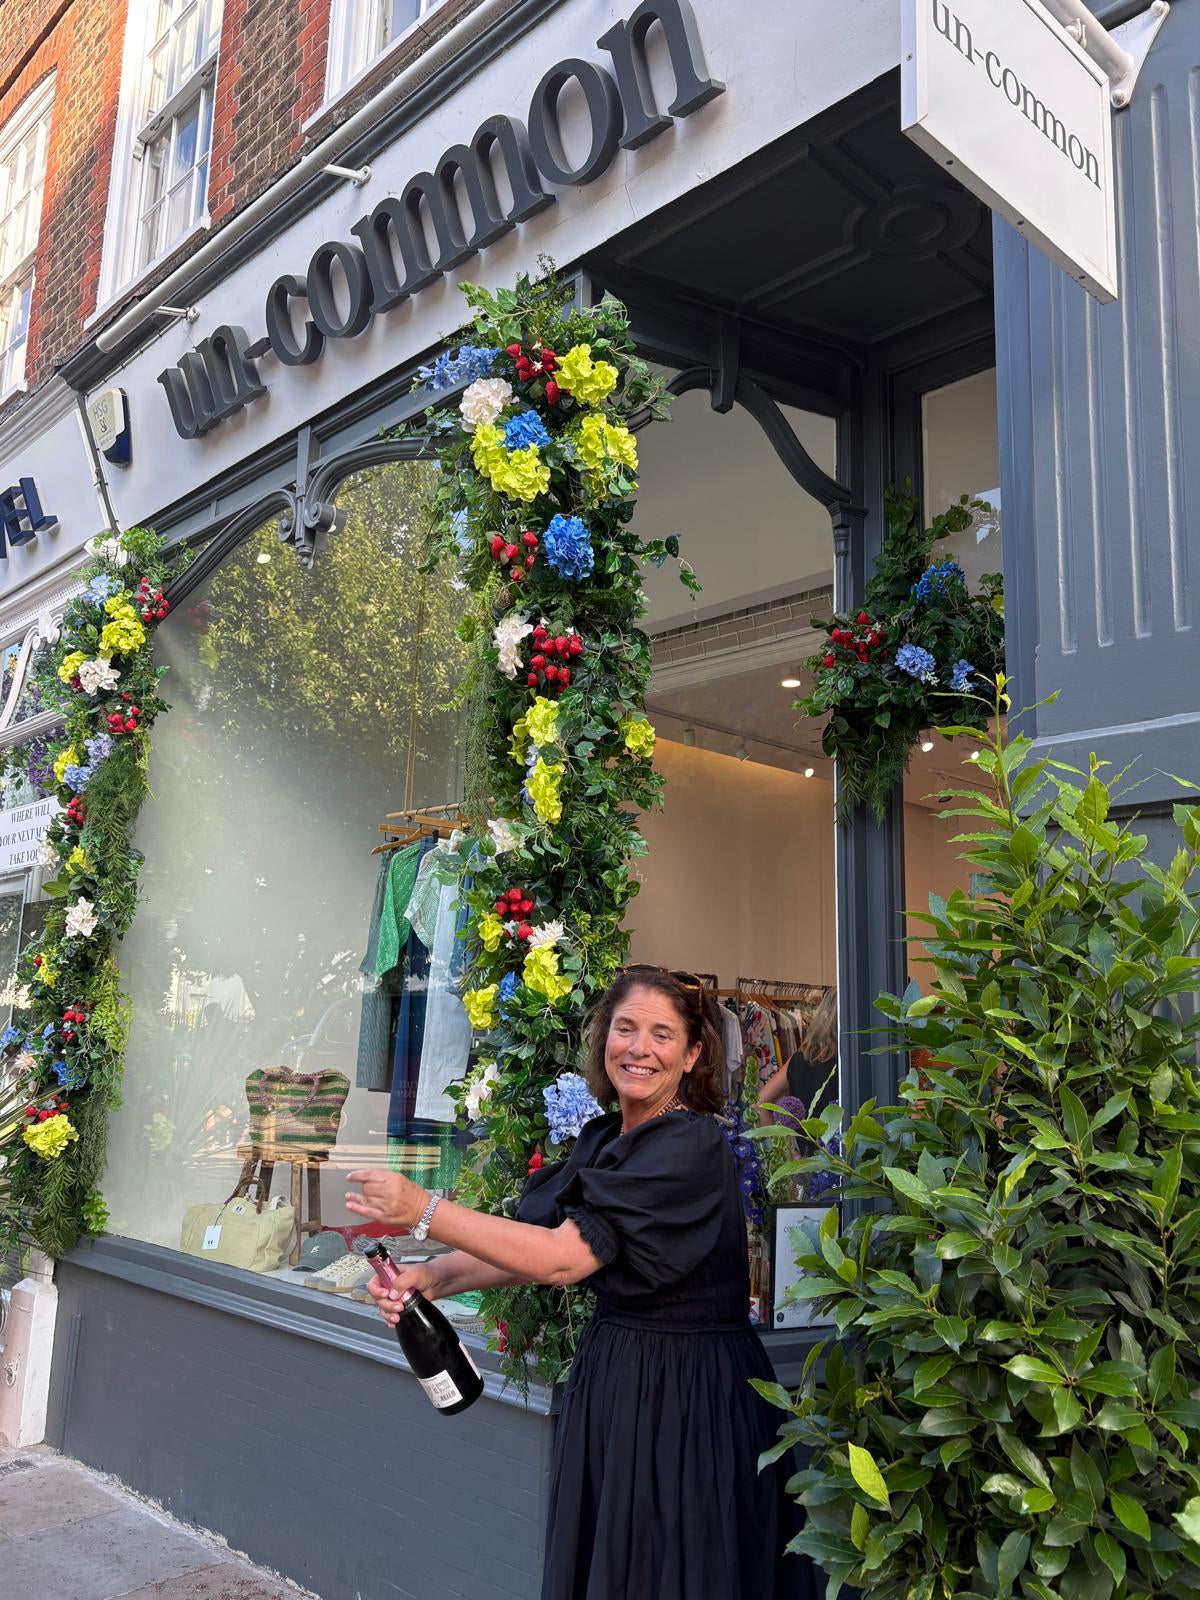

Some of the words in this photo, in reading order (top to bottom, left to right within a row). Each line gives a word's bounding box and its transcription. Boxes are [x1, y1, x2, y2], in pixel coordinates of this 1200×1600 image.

[932, 0, 1101, 190] un-common
[157, 0, 726, 440] un-common
[11, 807, 33, 823] WHERE
[35, 803, 50, 817] WILL
[18, 828, 34, 842] NEXT
[9, 851, 25, 866] TAKE
